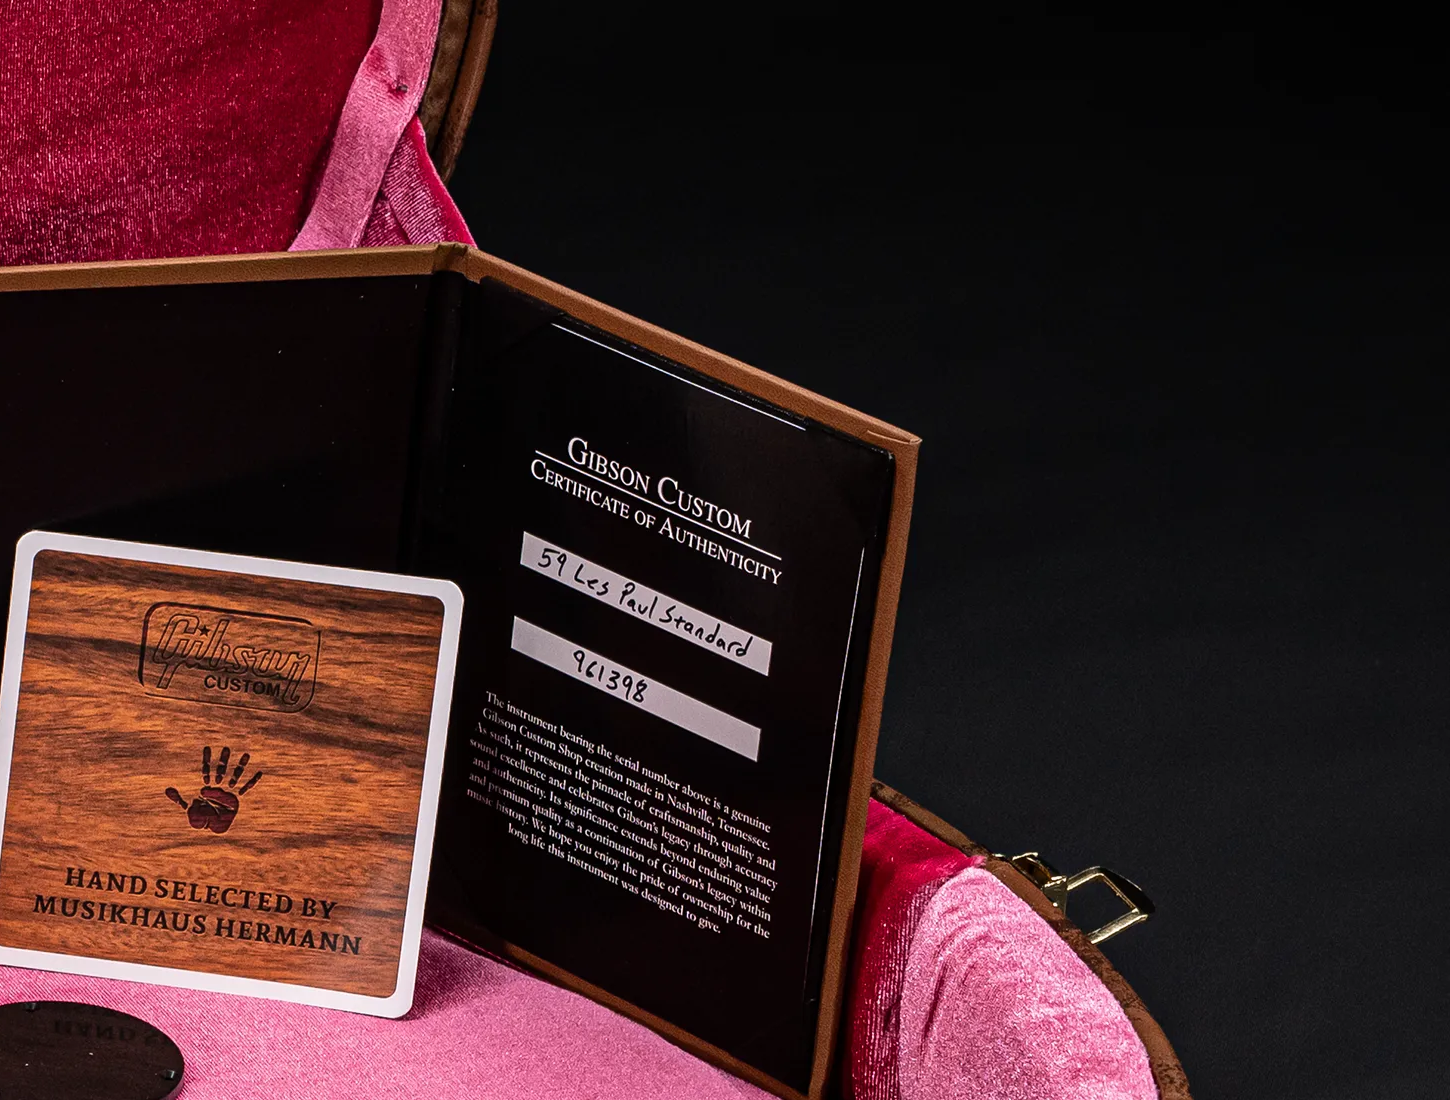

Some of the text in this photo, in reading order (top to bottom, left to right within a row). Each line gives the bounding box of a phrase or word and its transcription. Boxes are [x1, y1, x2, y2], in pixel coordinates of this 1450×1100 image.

[537, 547, 753, 657] 59 Les Paul Standard
[152, 613, 311, 706] Gibson
[203, 673, 280, 697] CUSTOM
[572, 649, 648, 703] 961398
[482, 707, 769, 850] Gibson Custom Shop creation made in Nashville, Tennessee.
[486, 690, 770, 832] The instrument bearing the serial number above is genuine
[489, 731, 775, 870] such, it represents the pinnacle of craftsmanship, quality and
[468, 773, 486, 785] and
[531, 803, 562, 825] quality
[584, 828, 644, 862] continuation
[707, 882, 737, 907] legacy
[739, 900, 770, 921] within
[472, 757, 489, 770] and
[549, 790, 561, 805] Its
[563, 799, 618, 832] significance
[620, 828, 657, 850] extends
[660, 842, 695, 869] beyond
[698, 864, 742, 893] enduring
[744, 885, 770, 903] value
[500, 753, 546, 780] excellence
[548, 776, 566, 790] and
[568, 785, 614, 812] celebrates
[661, 825, 690, 851] legacy
[693, 842, 732, 868] through
[734, 863, 777, 891] accuracy
[508, 822, 720, 933] long life this instrument was designed give.
[32, 894, 362, 956] MUSIKHAUS HERMANN
[64, 866, 338, 920] HAND SELECTED BY
[548, 824, 572, 845] hope
[574, 840, 591, 854] you
[594, 850, 619, 870] enjoy
[622, 861, 637, 876] the
[639, 871, 665, 889] pride
[682, 892, 733, 923] ownership
[736, 914, 751, 929] for
[754, 923, 769, 938] the
